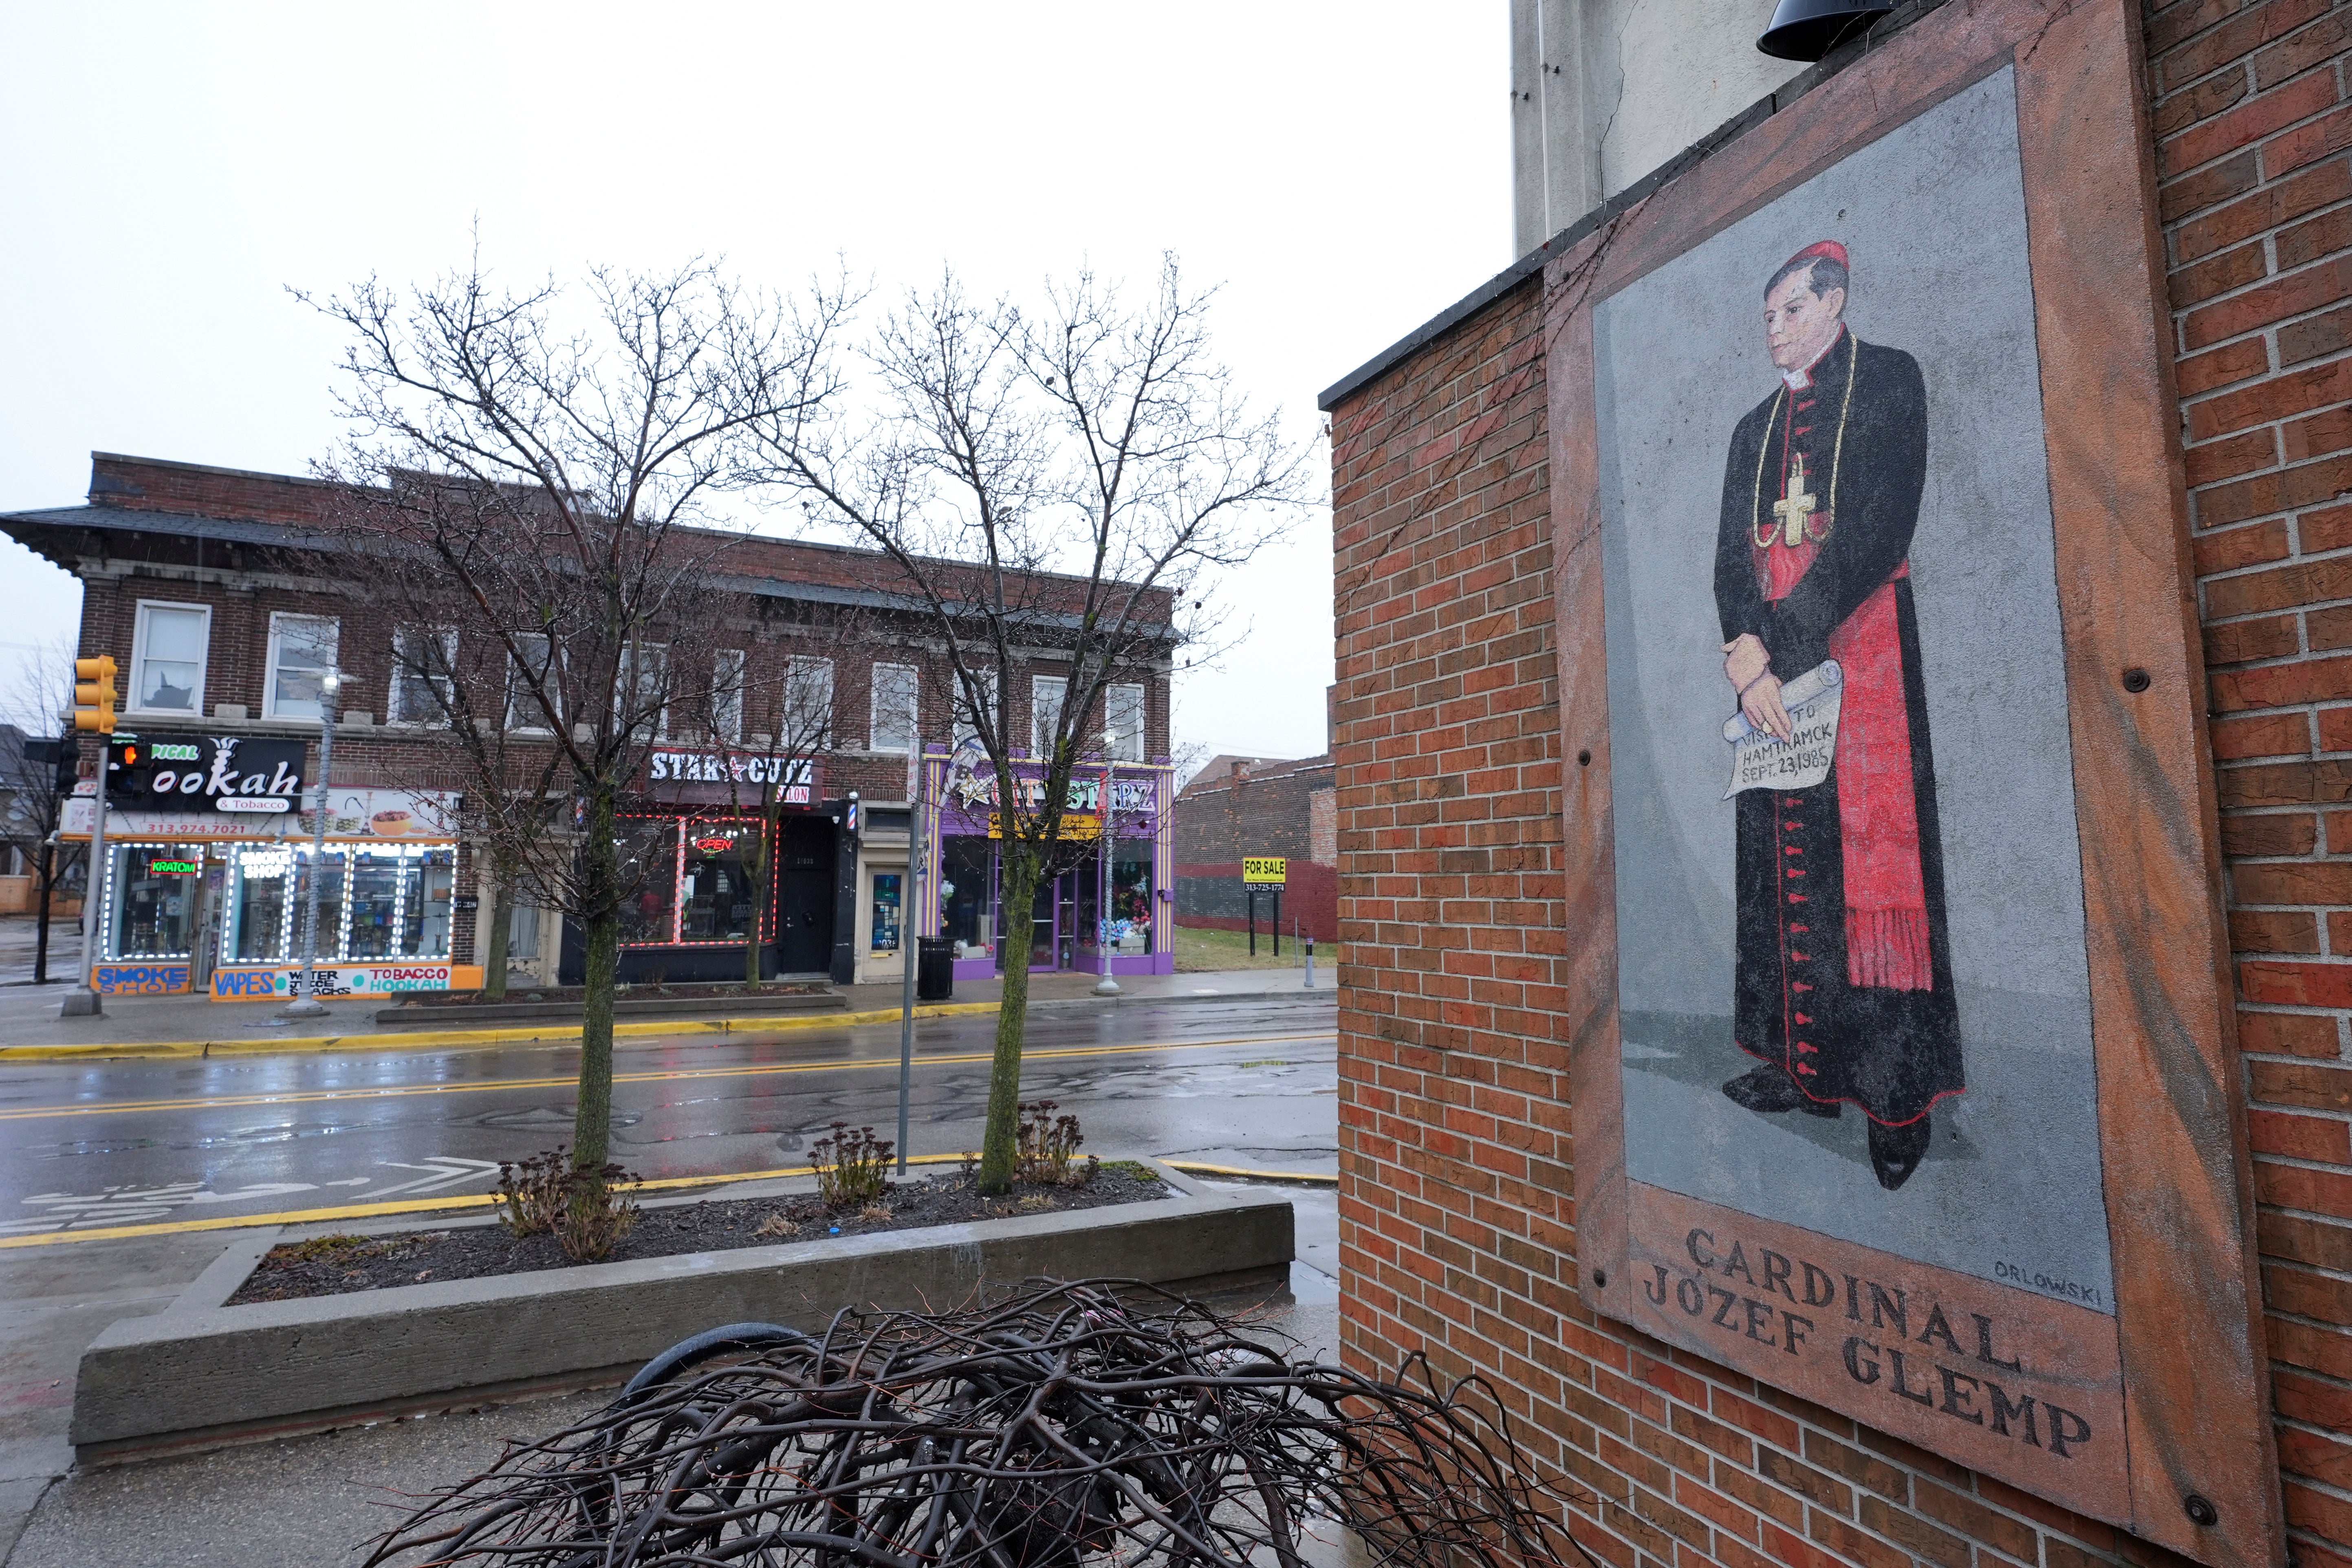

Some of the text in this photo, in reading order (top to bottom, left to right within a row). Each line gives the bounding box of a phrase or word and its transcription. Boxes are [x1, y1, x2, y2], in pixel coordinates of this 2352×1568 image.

[1793, 705, 1815, 722] TO
[1743, 721, 1832, 766] HAMTRAMCK
[152, 737, 299, 795] ookah
[650, 752, 720, 782] STAR
[1742, 763, 1777, 783] SEPT.
[220, 799, 284, 809] & Tobacco
[1065, 780, 1156, 812] STRZ
[696, 839, 733, 850] OPEN
[239, 851, 291, 865] SMOKE
[152, 861, 195, 873] KRATOM
[244, 864, 285, 879] SHOP
[1245, 861, 1284, 874] FOR SALE
[97, 967, 188, 984] SMOKE
[370, 968, 448, 980] TOBACCO
[100, 982, 182, 993] SHOP
[214, 971, 275, 996] VAPES
[289, 987, 351, 996] SACKS
[370, 980, 446, 992] HOOKAH
[1995, 1260, 2101, 1306] ORLOWSKI
[1686, 1227, 2022, 1374] CARDINAL
[1643, 1264, 2092, 1460] JÓZEF GLEMP
